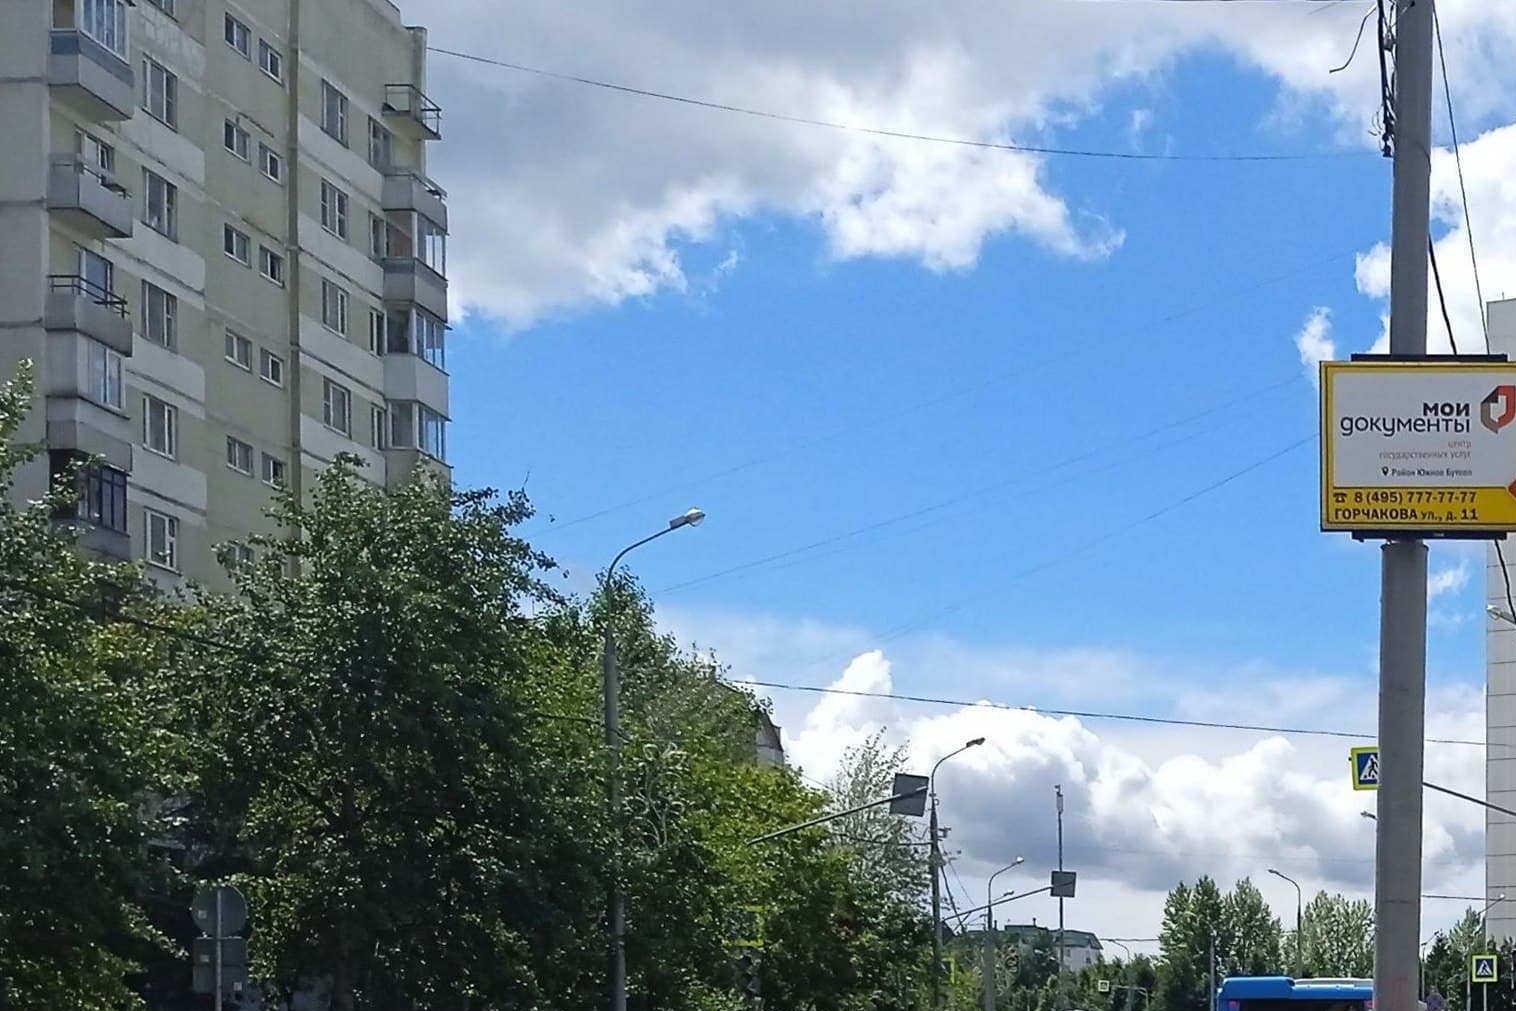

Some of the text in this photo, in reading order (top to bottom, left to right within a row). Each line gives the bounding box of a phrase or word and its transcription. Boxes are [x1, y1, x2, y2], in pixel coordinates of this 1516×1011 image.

[1340, 416, 1471, 437] документы
[1353, 491, 1477, 505] 8 (495) 777-77-77
[1334, 508, 1418, 521] ГОРЧАКОВА
[1461, 508, 1478, 520] 11
